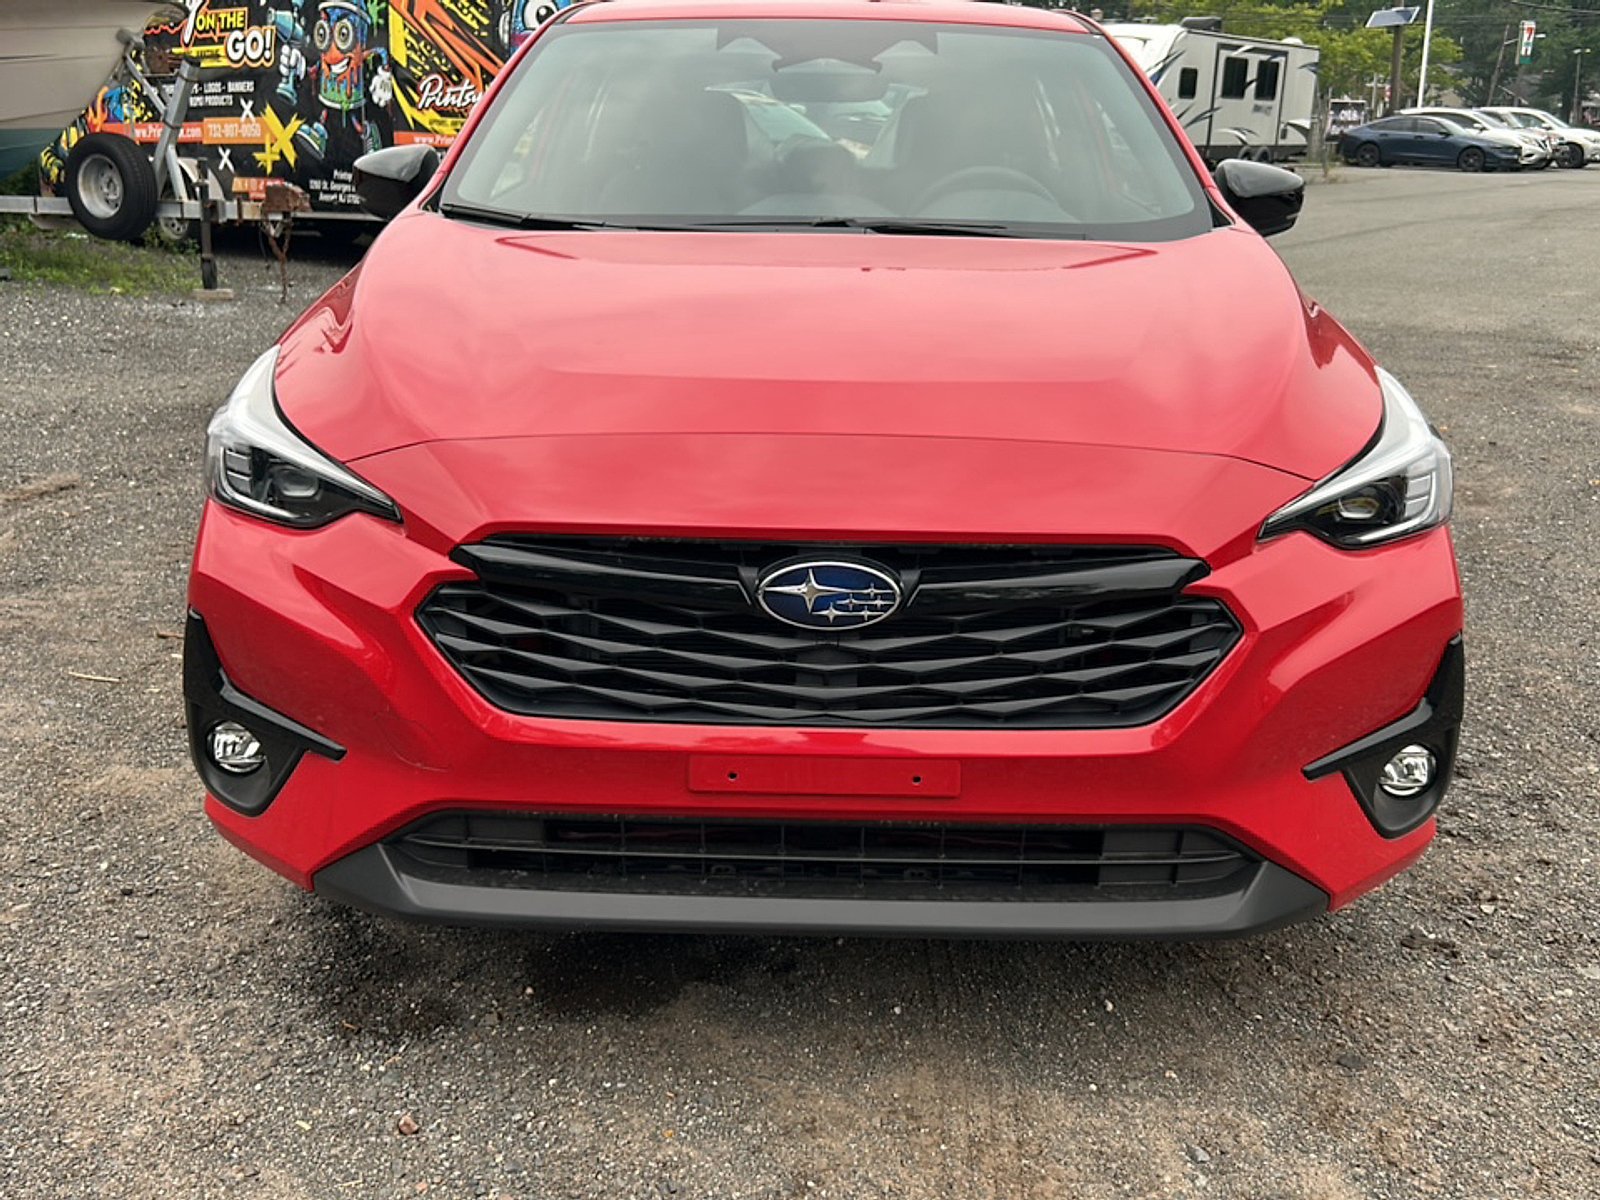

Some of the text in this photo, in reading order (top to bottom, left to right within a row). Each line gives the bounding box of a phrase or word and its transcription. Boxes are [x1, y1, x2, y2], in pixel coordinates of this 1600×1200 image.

[196, 12, 245, 31] ON THE
[227, 29, 271, 61] GO!
[228, 80, 254, 93] BANNERS
[189, 94, 233, 107] ROMO PRODUCTS
